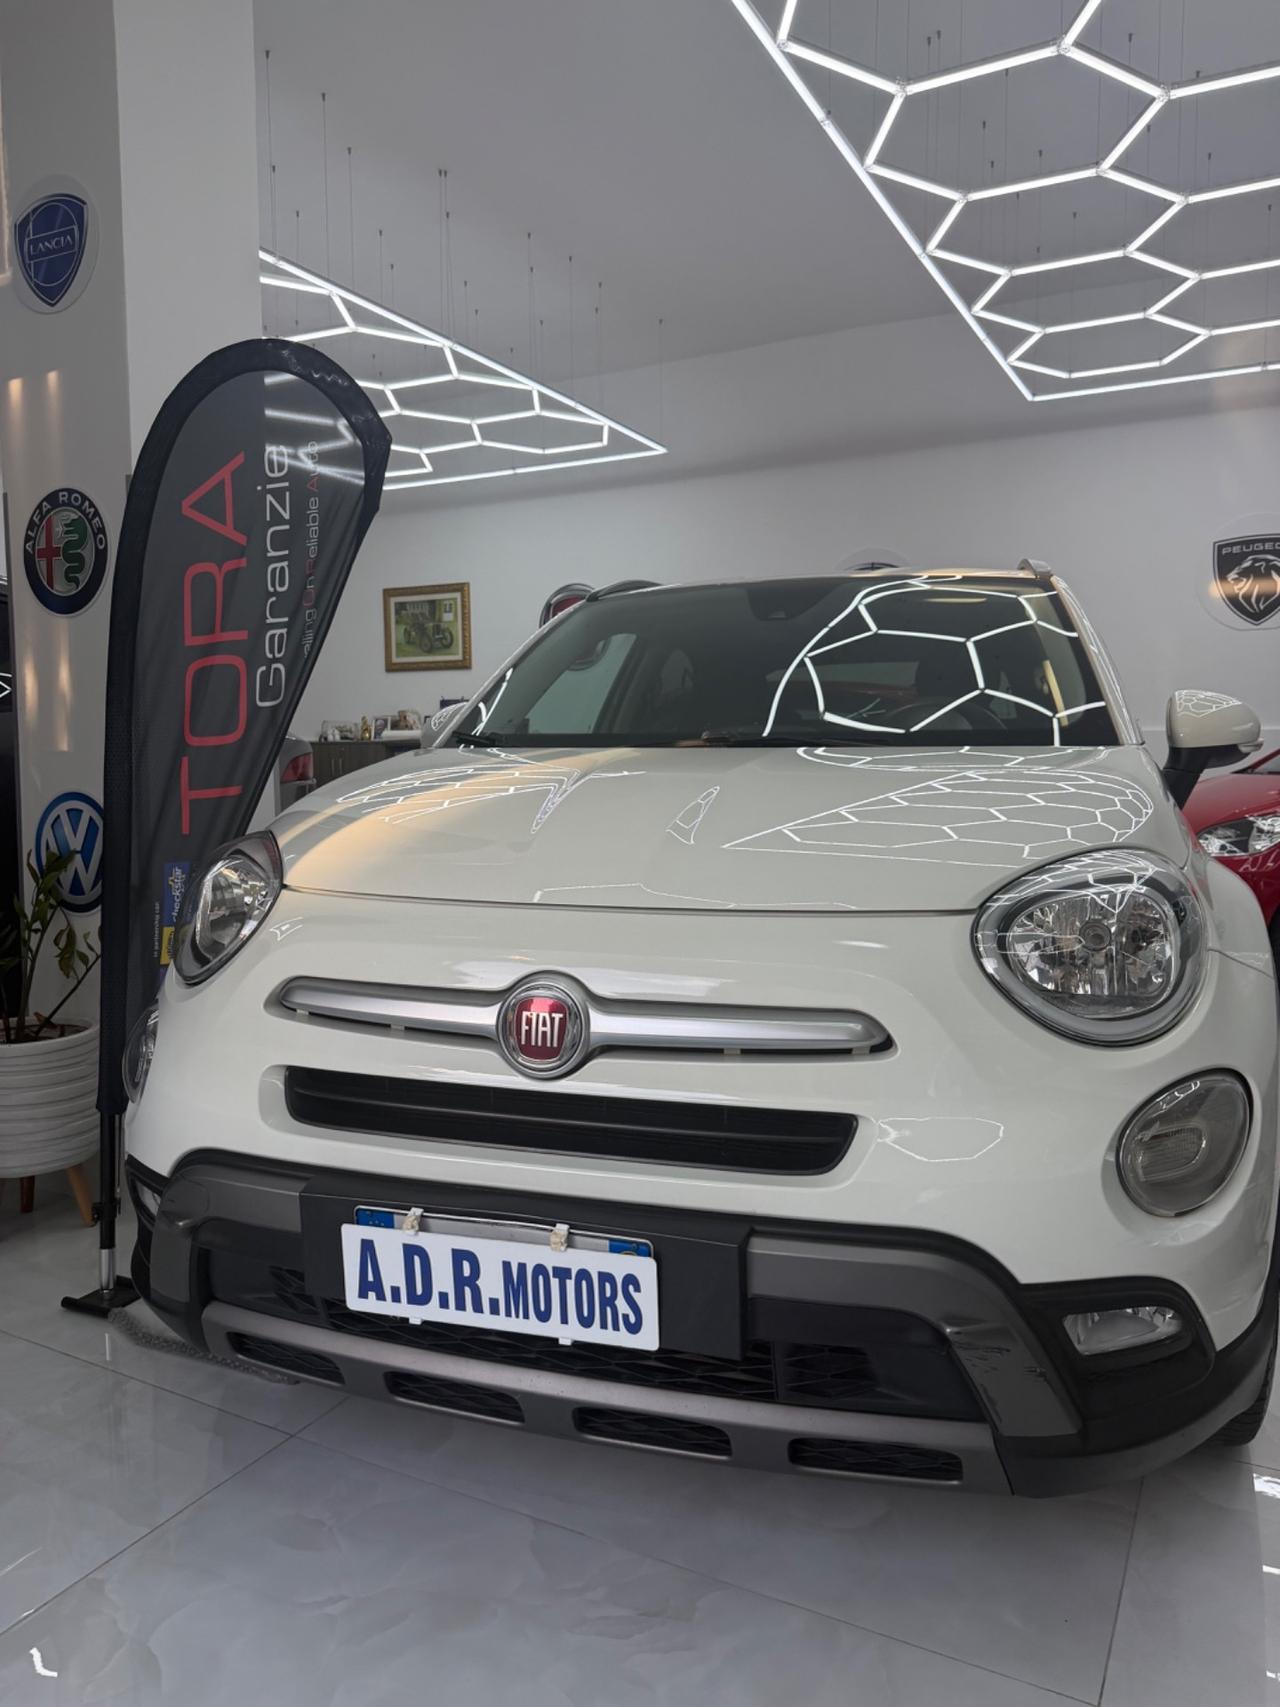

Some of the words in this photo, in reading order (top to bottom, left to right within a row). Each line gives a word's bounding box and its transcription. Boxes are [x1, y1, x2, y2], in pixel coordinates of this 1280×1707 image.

[30, 234, 73, 256] LANCIA
[307, 440, 320, 492] Auto
[25, 500, 52, 555] ALFA
[58, 491, 106, 550] ROMEO
[305, 497, 319, 574] Reliable
[256, 443, 290, 708] Garanzie
[180, 450, 249, 836] TORA
[301, 608, 317, 659] elling
[521, 1010, 564, 1048] FIAT
